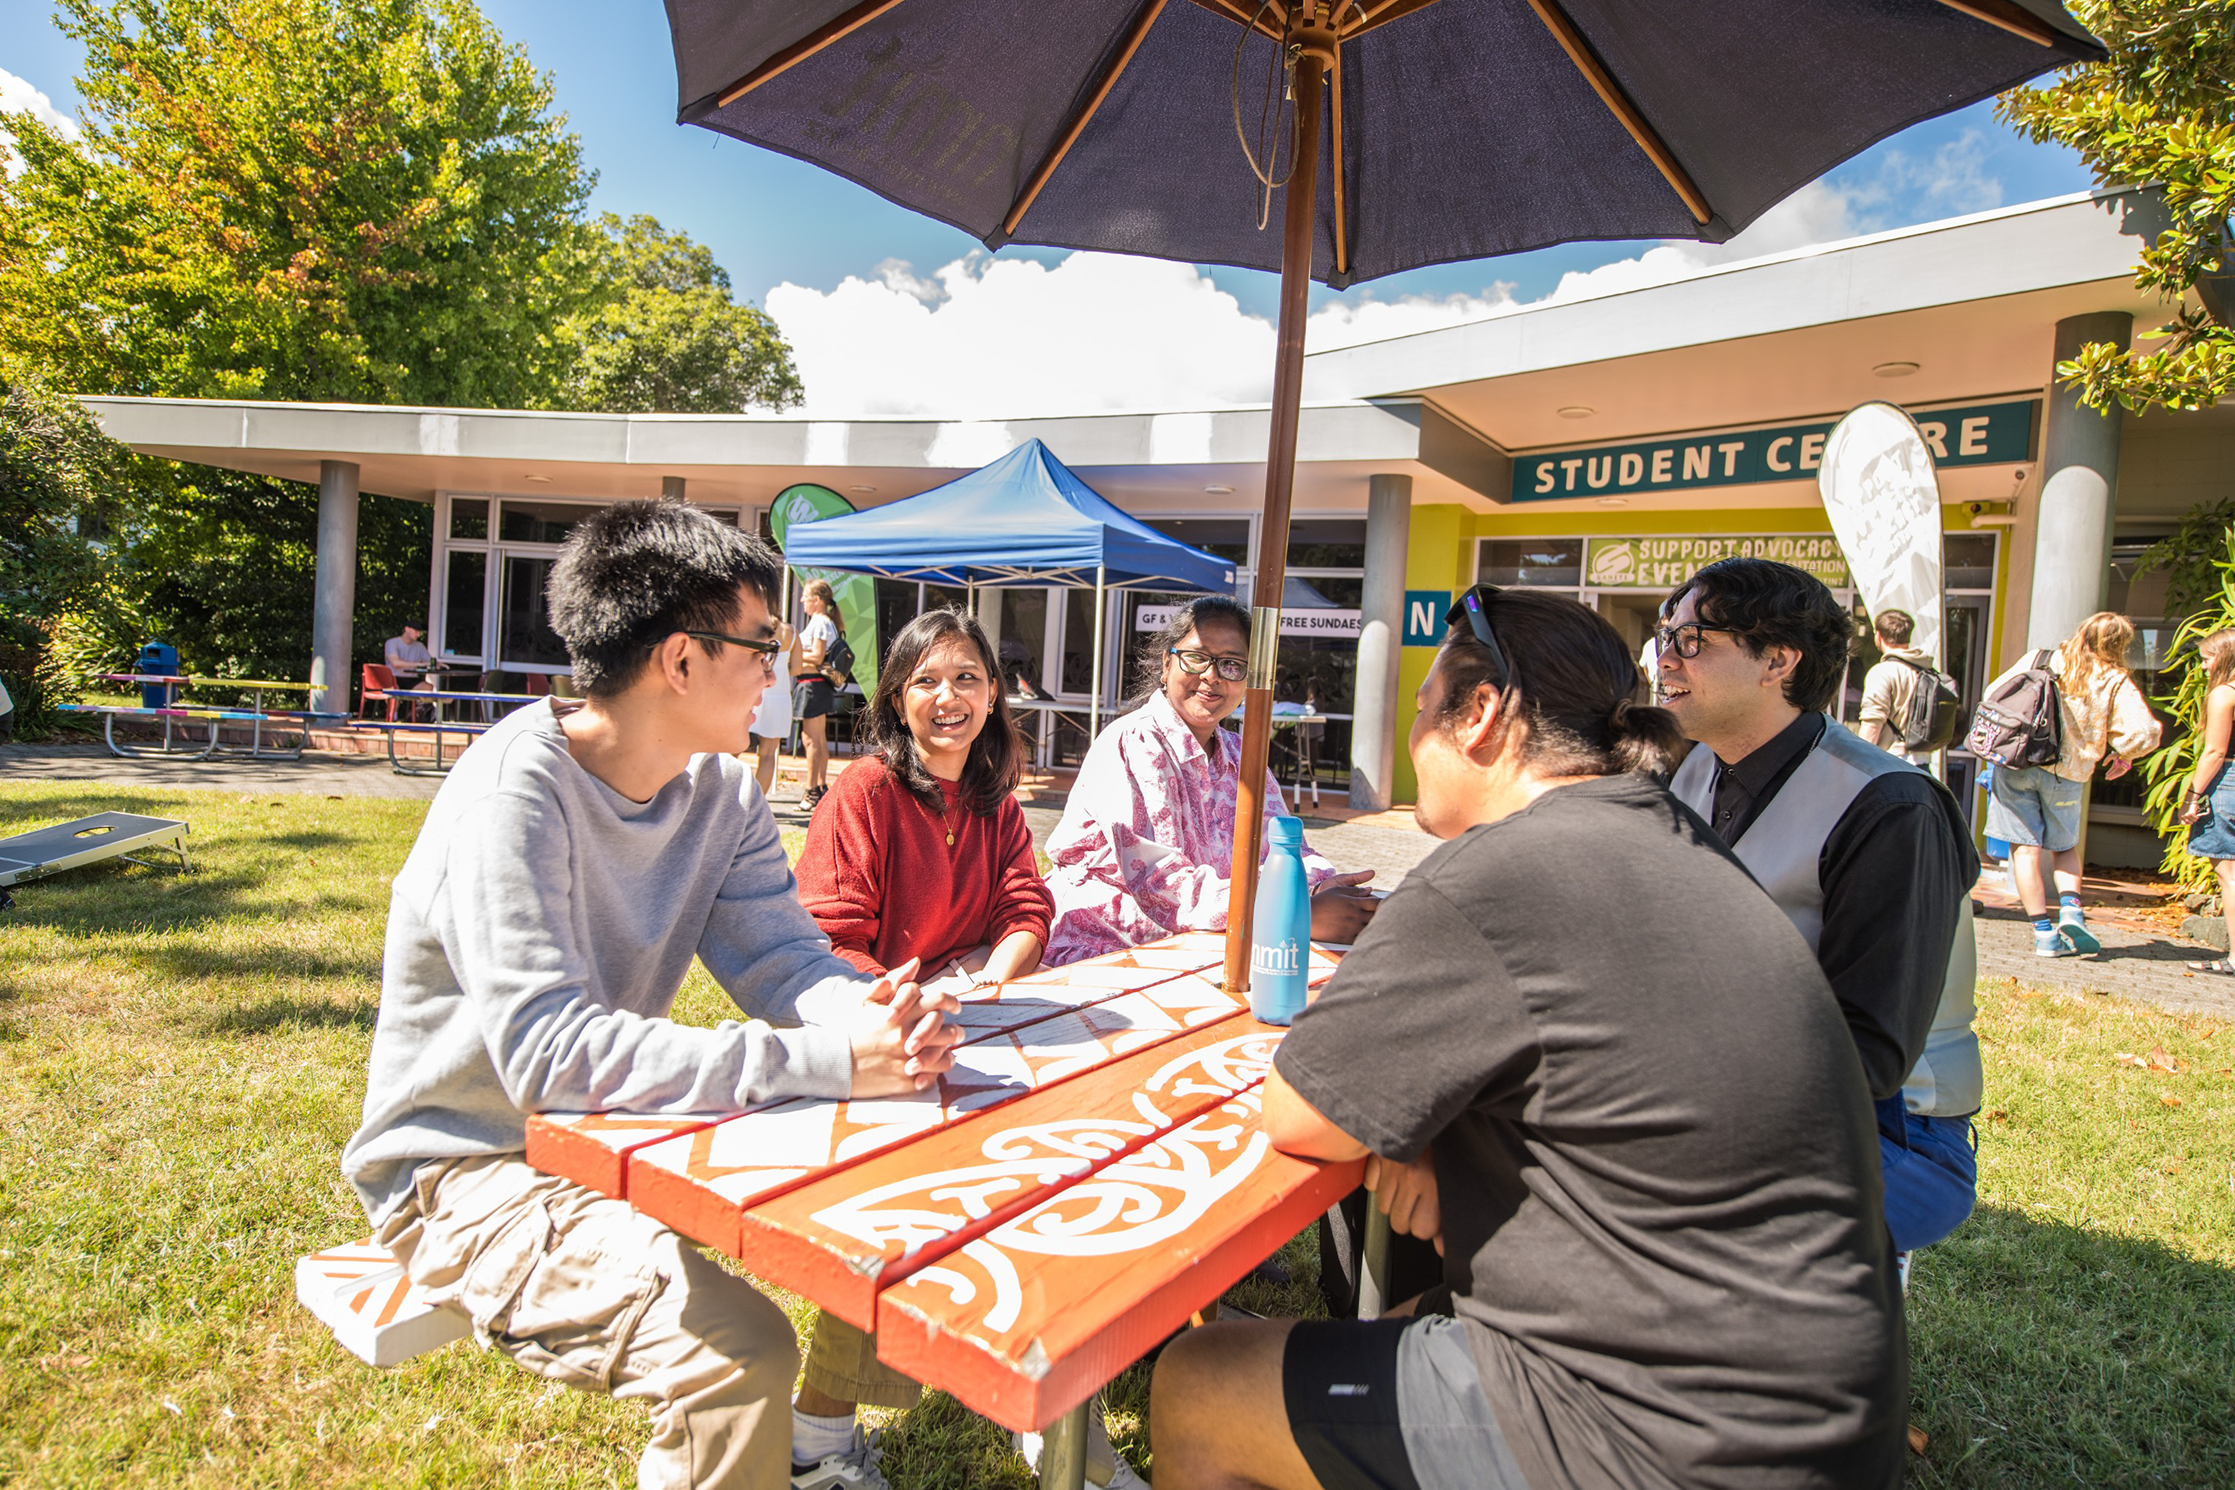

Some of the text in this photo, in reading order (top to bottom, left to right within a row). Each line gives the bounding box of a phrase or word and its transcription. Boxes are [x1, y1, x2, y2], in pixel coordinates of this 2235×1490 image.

[1534, 416, 1990, 494] STUDENT CERE
[1639, 540, 1737, 560] SUPPORT
[1638, 561, 1704, 585] EVEN
[1142, 613, 1157, 624] GF
[1160, 613, 1166, 624] &
[1280, 616, 1308, 628] FREE
[1410, 601, 1435, 636] N
